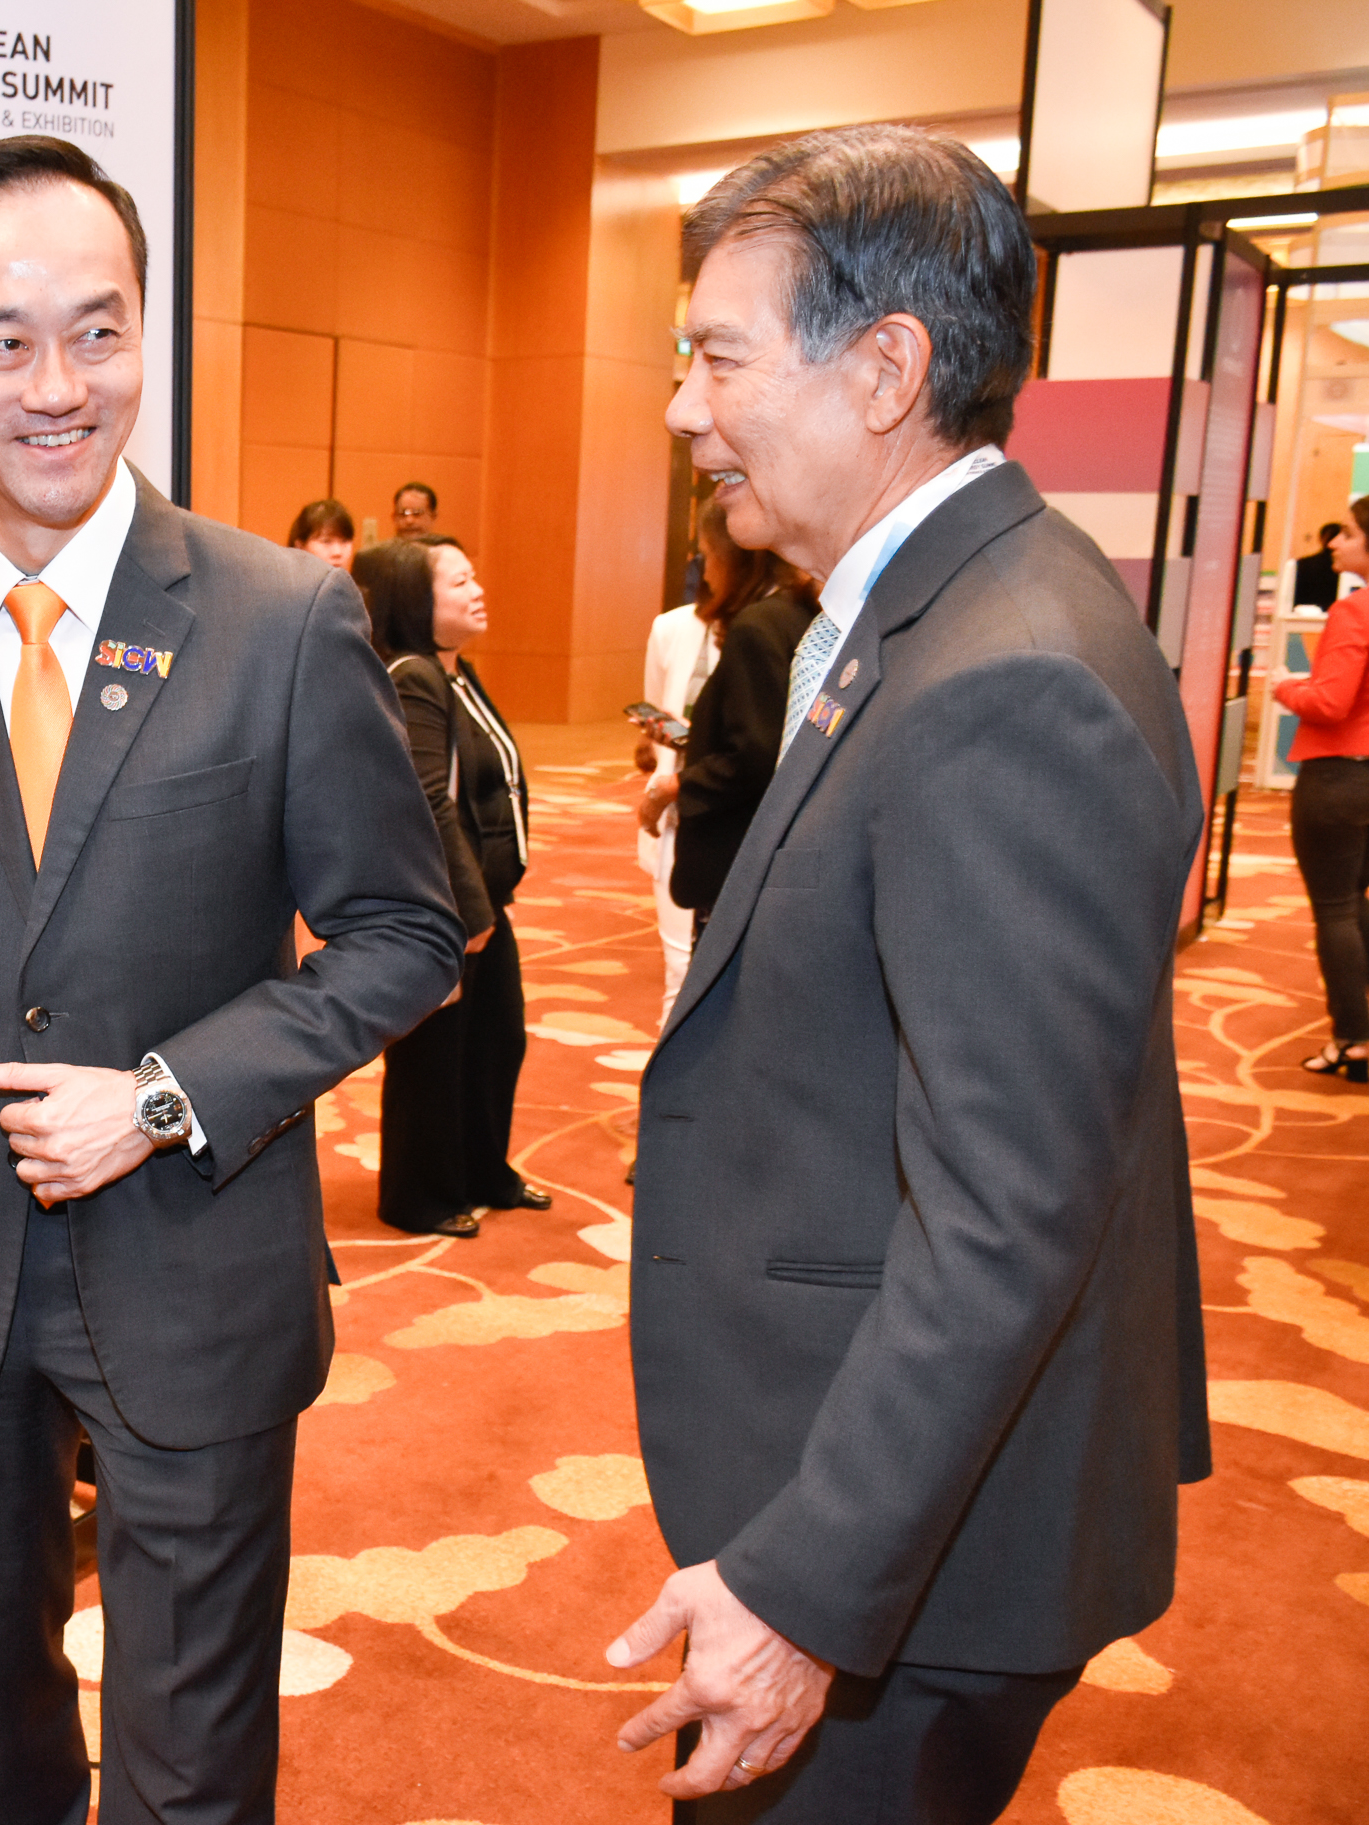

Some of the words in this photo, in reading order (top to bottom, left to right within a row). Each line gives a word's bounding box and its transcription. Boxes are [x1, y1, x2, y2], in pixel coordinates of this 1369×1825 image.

[1, 71, 114, 109] SUMMIT
[1, 109, 14, 127] &
[21, 111, 115, 138] EXHIBITION
